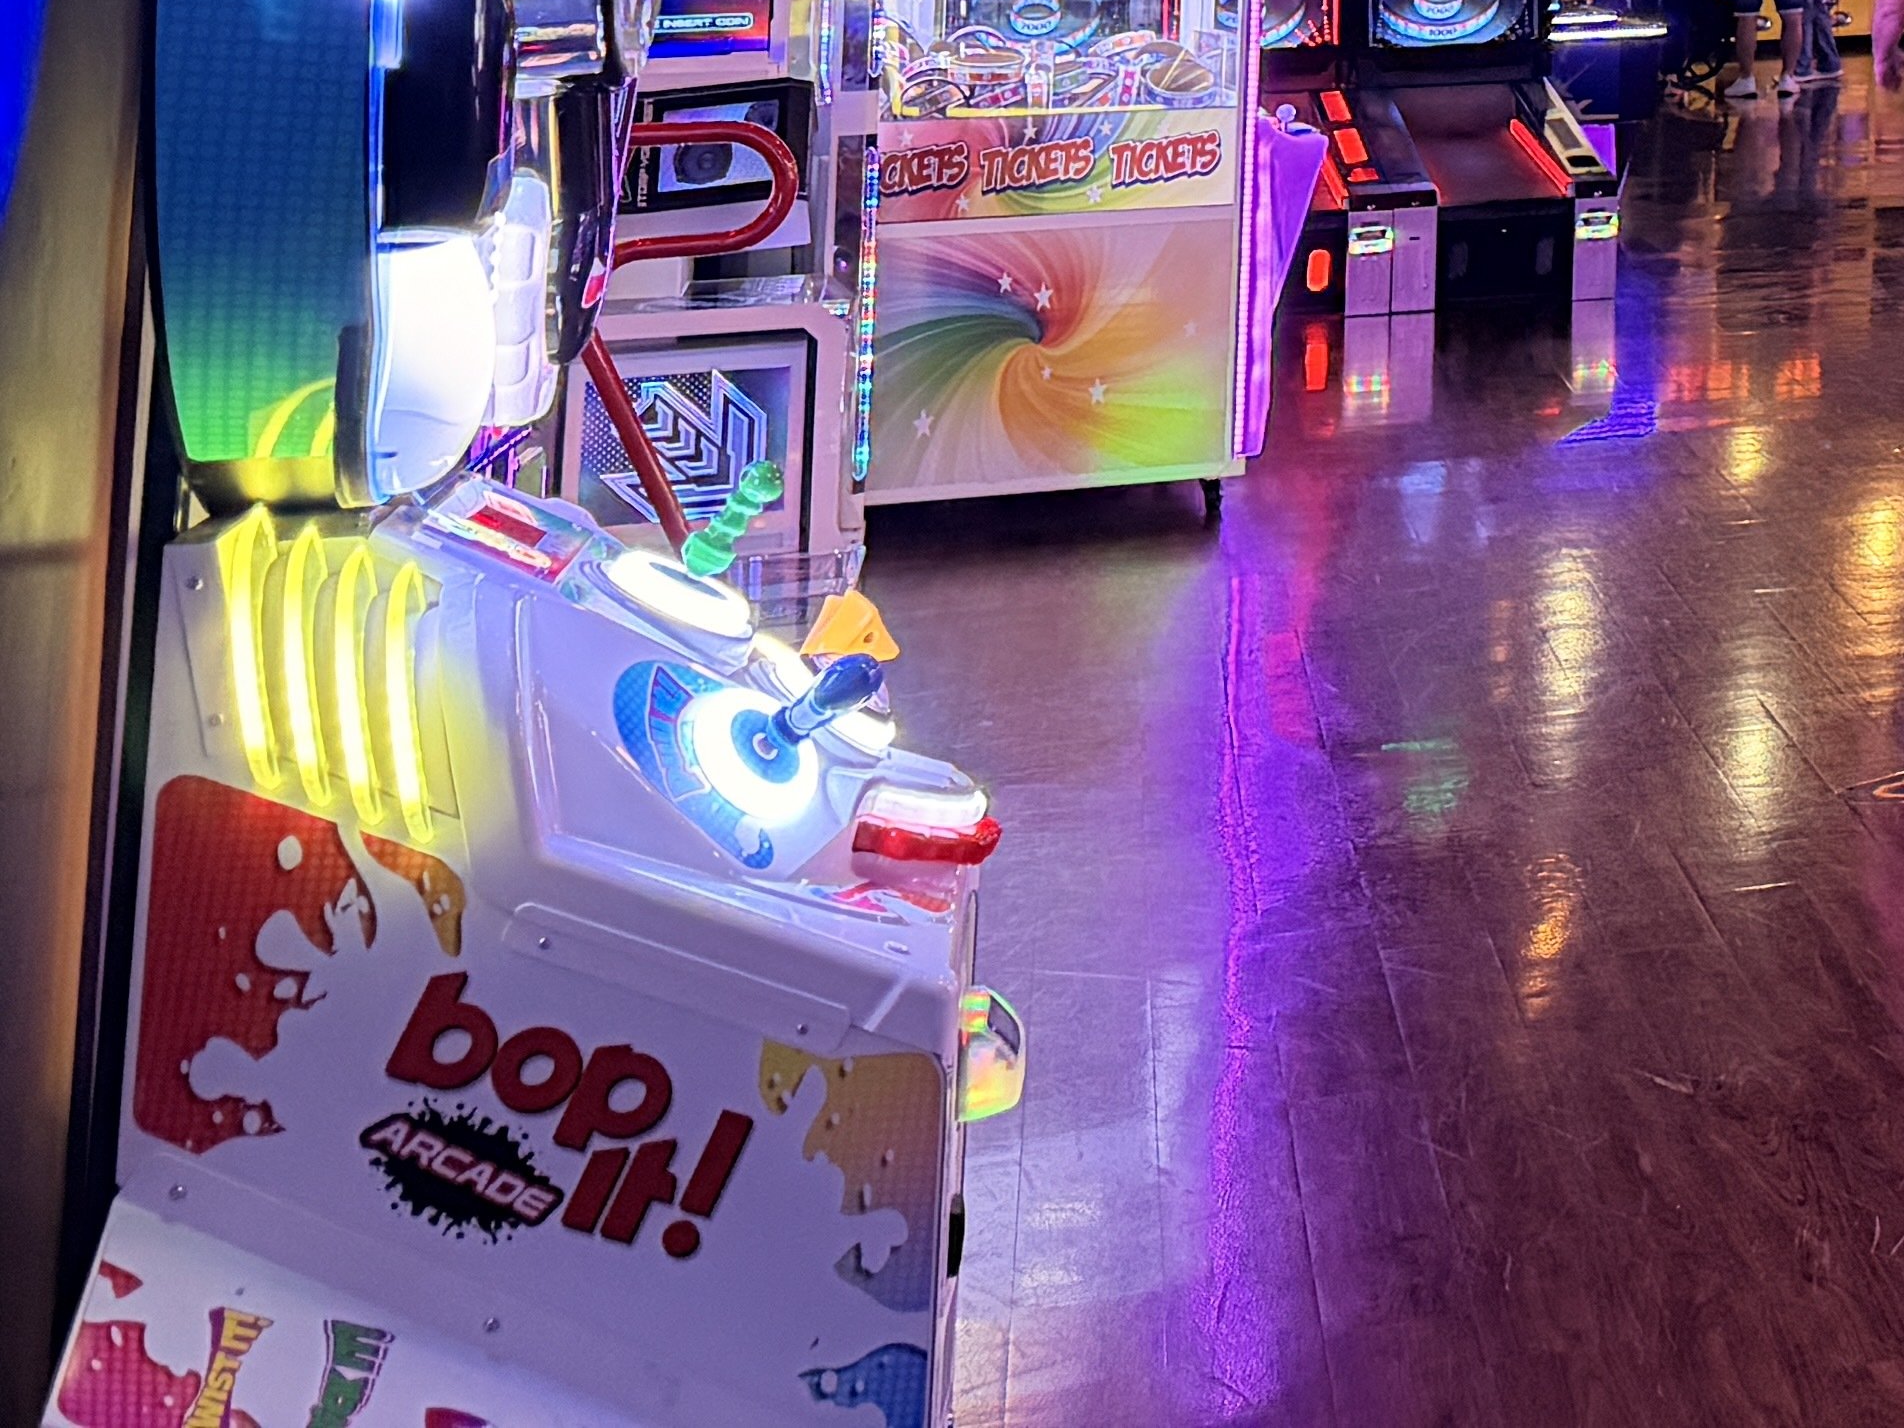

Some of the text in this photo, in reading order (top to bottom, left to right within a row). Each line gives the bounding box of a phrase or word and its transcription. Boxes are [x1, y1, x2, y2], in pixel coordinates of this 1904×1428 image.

[879, 129, 1223, 195] CKETS TICKETS TICKETS
[385, 970, 673, 1153] bop
[369, 1116, 558, 1220] ARCADE
[184, 1351, 242, 1428] WIST
